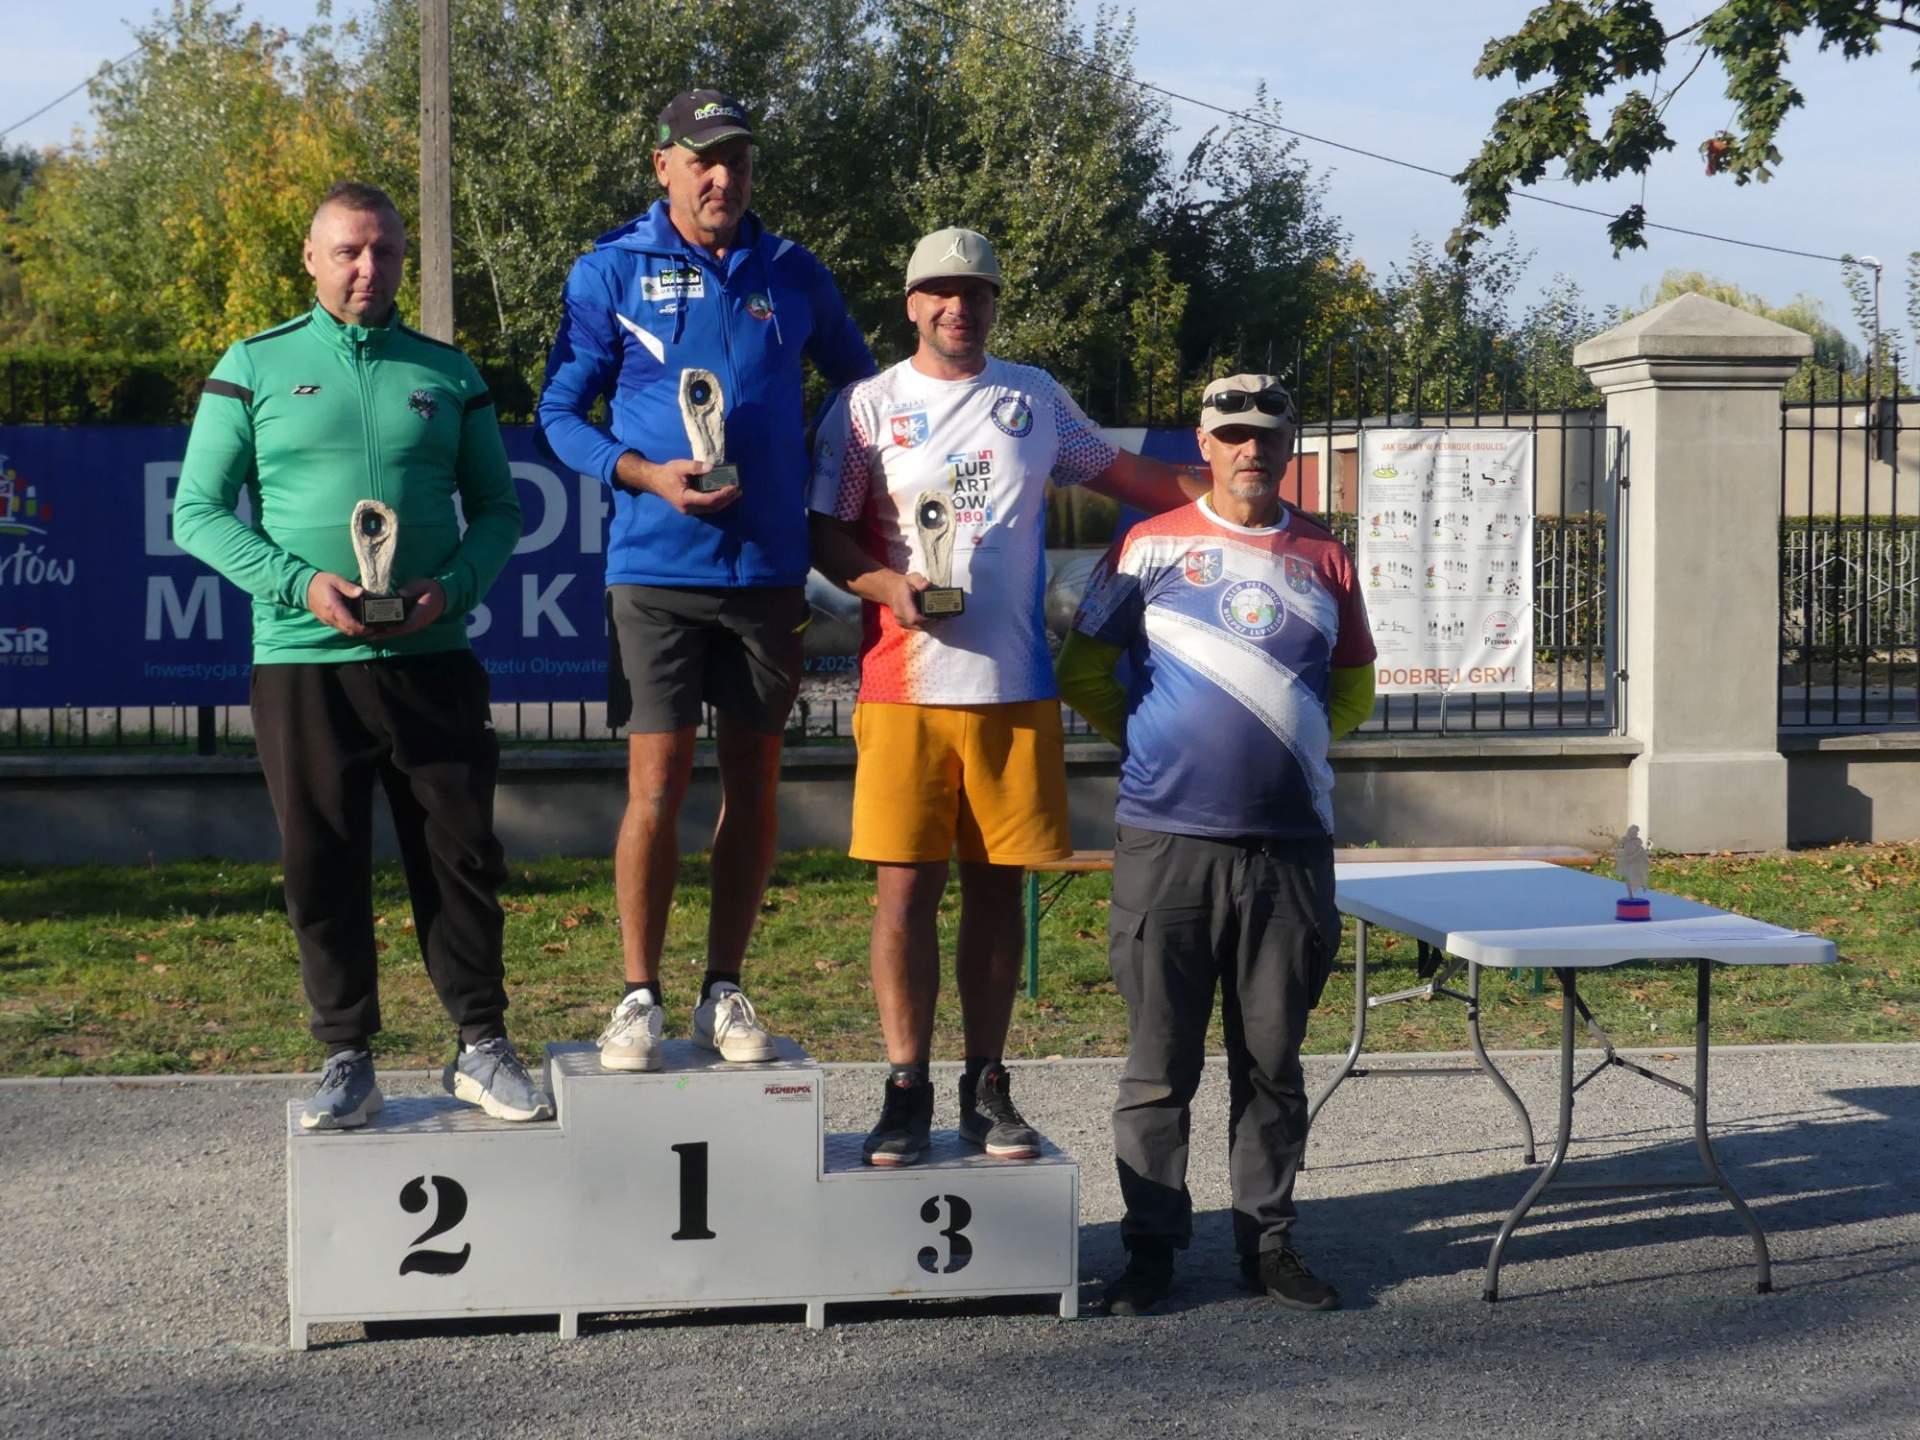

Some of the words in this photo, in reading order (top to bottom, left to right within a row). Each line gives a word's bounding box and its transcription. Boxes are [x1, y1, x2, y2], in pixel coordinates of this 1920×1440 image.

[954, 477, 991, 494] ART
[956, 461, 991, 477] LUB
[1378, 668, 1460, 685] DOBREJ
[1468, 666, 1516, 684] GRY!
[670, 1141, 717, 1242] 1
[398, 1174, 471, 1277] 2
[916, 1193, 973, 1276] 3
